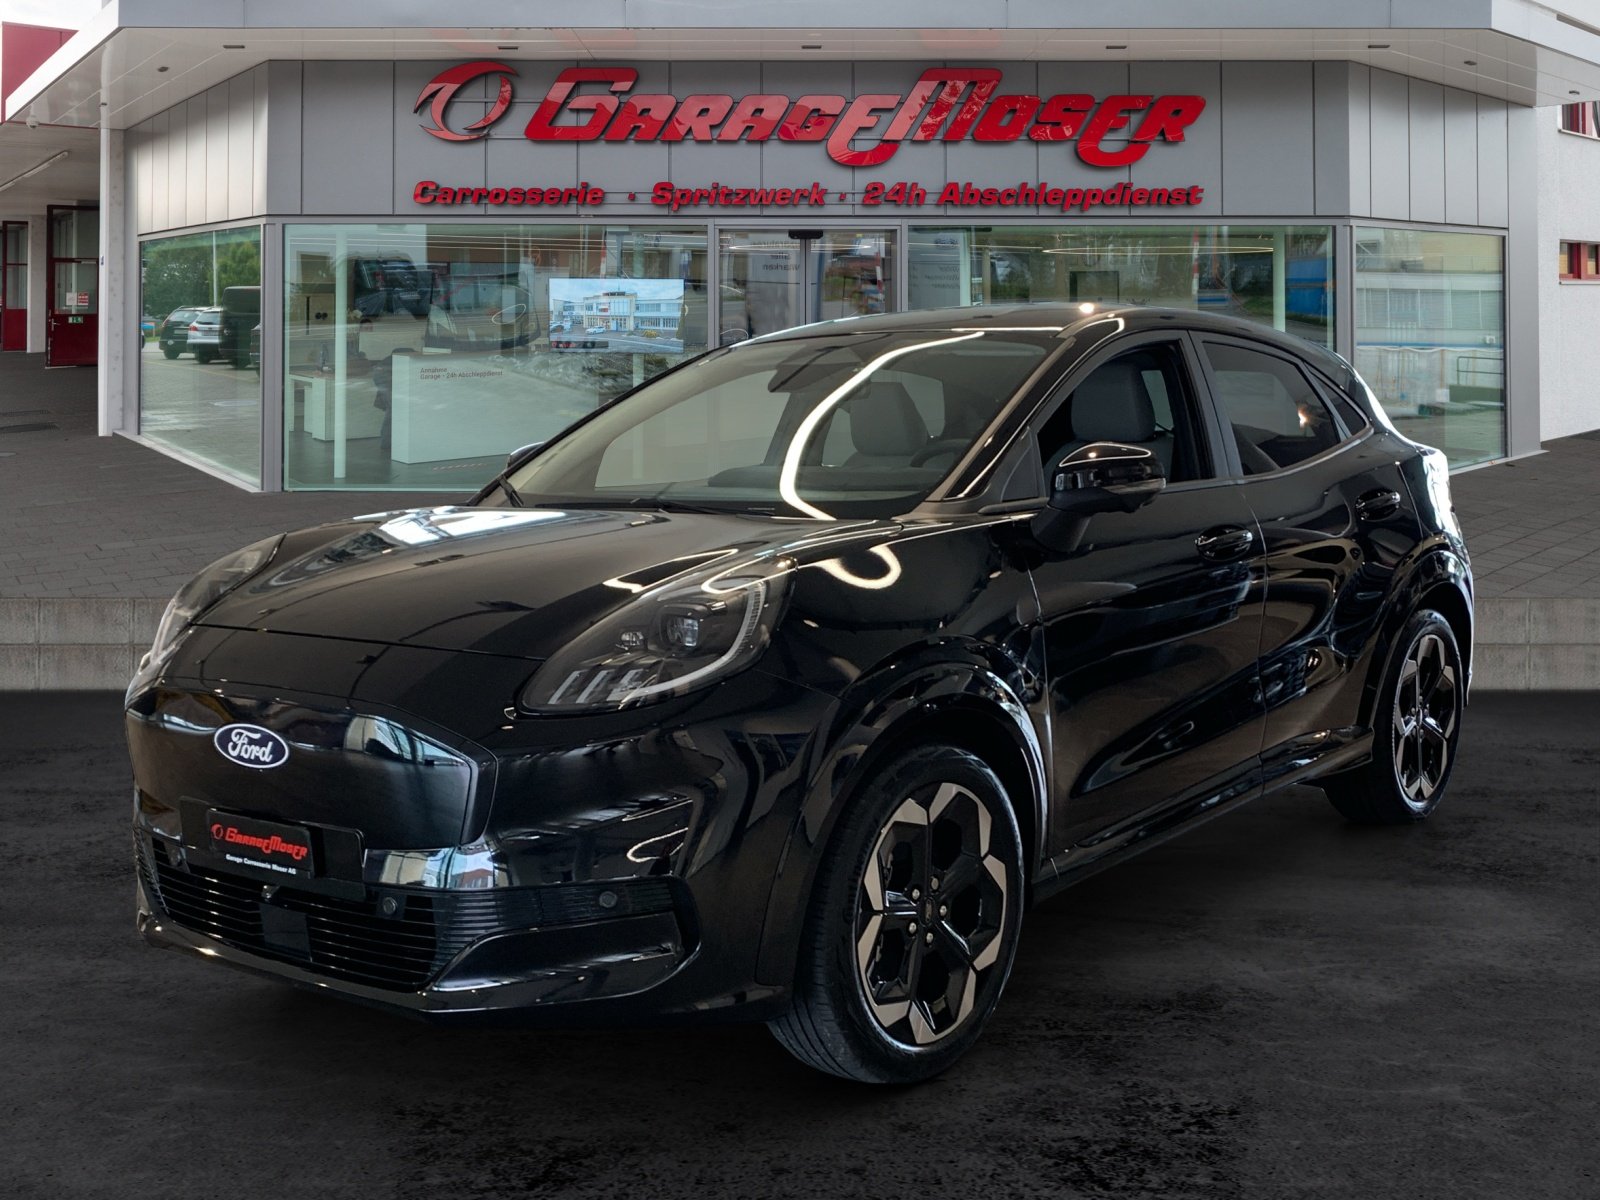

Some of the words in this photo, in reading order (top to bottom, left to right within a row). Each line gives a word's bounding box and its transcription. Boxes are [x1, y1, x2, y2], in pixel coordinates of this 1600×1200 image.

[413, 180, 605, 205] Carrosserie
[651, 182, 826, 211] Spritzwerk
[863, 182, 926, 205] 24h
[936, 182, 1204, 211] Abschleppdienst
[228, 728, 273, 762] Ford
[225, 854, 243, 863] Garage
[272, 863, 288, 873] Moser
